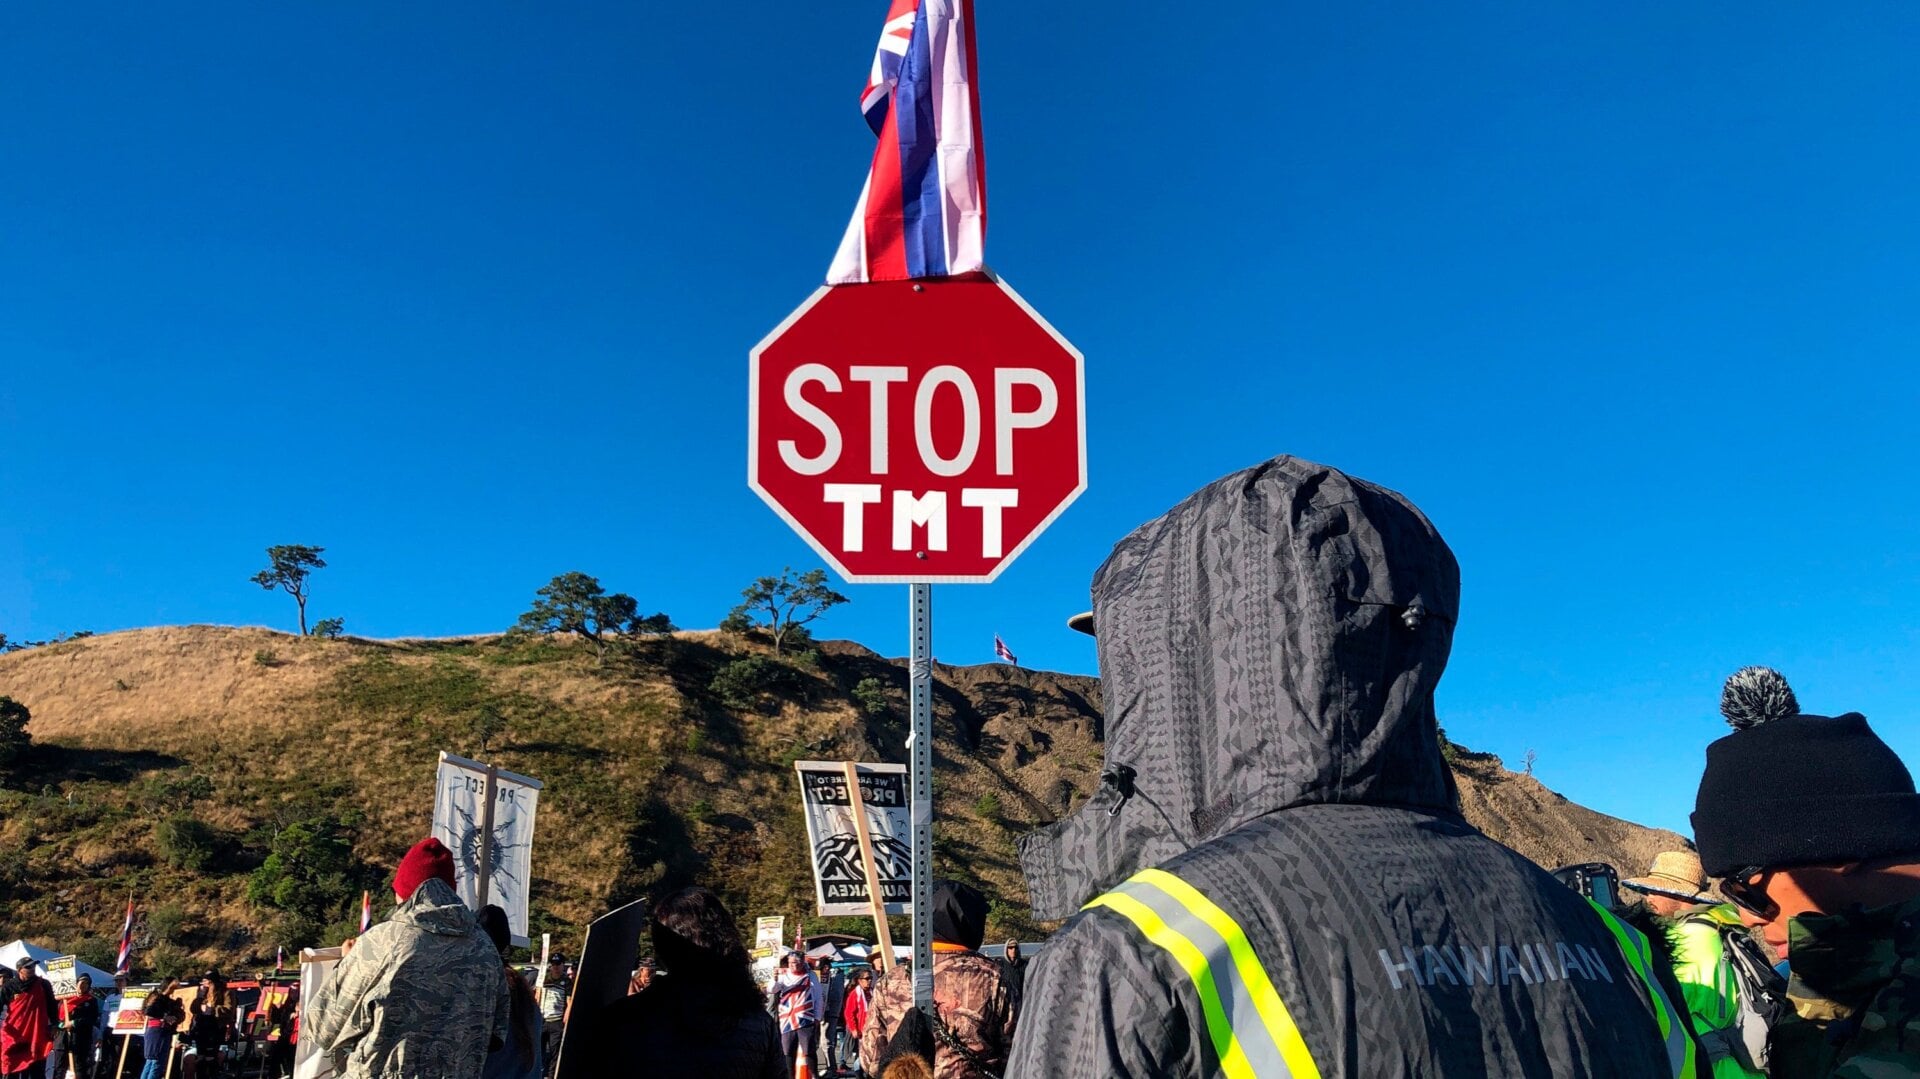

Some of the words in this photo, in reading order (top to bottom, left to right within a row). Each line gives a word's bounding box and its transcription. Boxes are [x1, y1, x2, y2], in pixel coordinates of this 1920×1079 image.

[777, 363, 1059, 477] STOP
[823, 483, 1019, 558] TMT
[1378, 942, 1614, 990] HAWAIIAN
